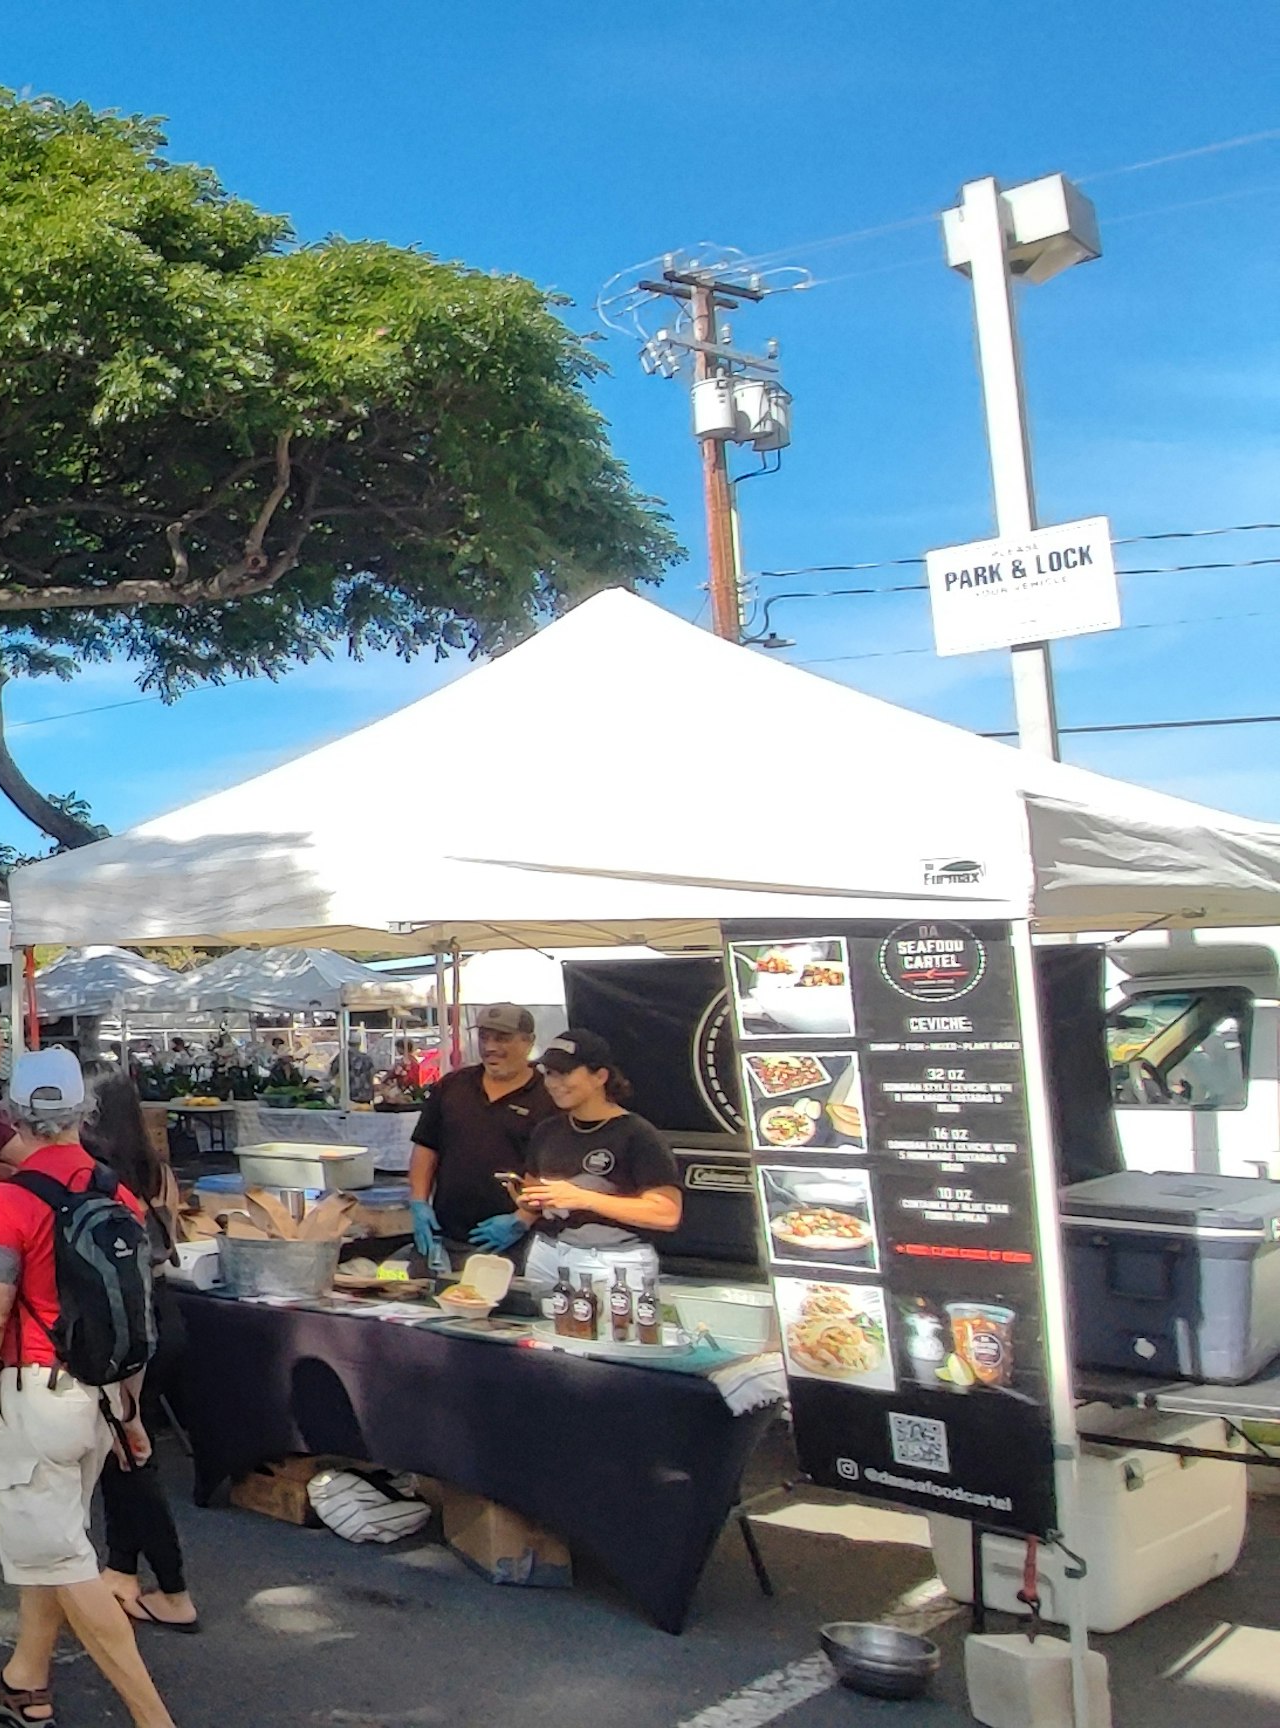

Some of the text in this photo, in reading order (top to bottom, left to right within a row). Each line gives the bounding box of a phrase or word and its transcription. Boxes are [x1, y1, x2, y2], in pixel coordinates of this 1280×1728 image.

[944, 544, 1093, 592] PARK & LOCK
[918, 925, 939, 939] DA
[896, 939, 965, 955] SEAFOOD
[902, 954, 962, 970] CARTEL
[927, 1068, 965, 1080] 32 OZ
[933, 1127, 969, 1141] 16 OZ
[937, 1187, 973, 1201] 10 OZ
